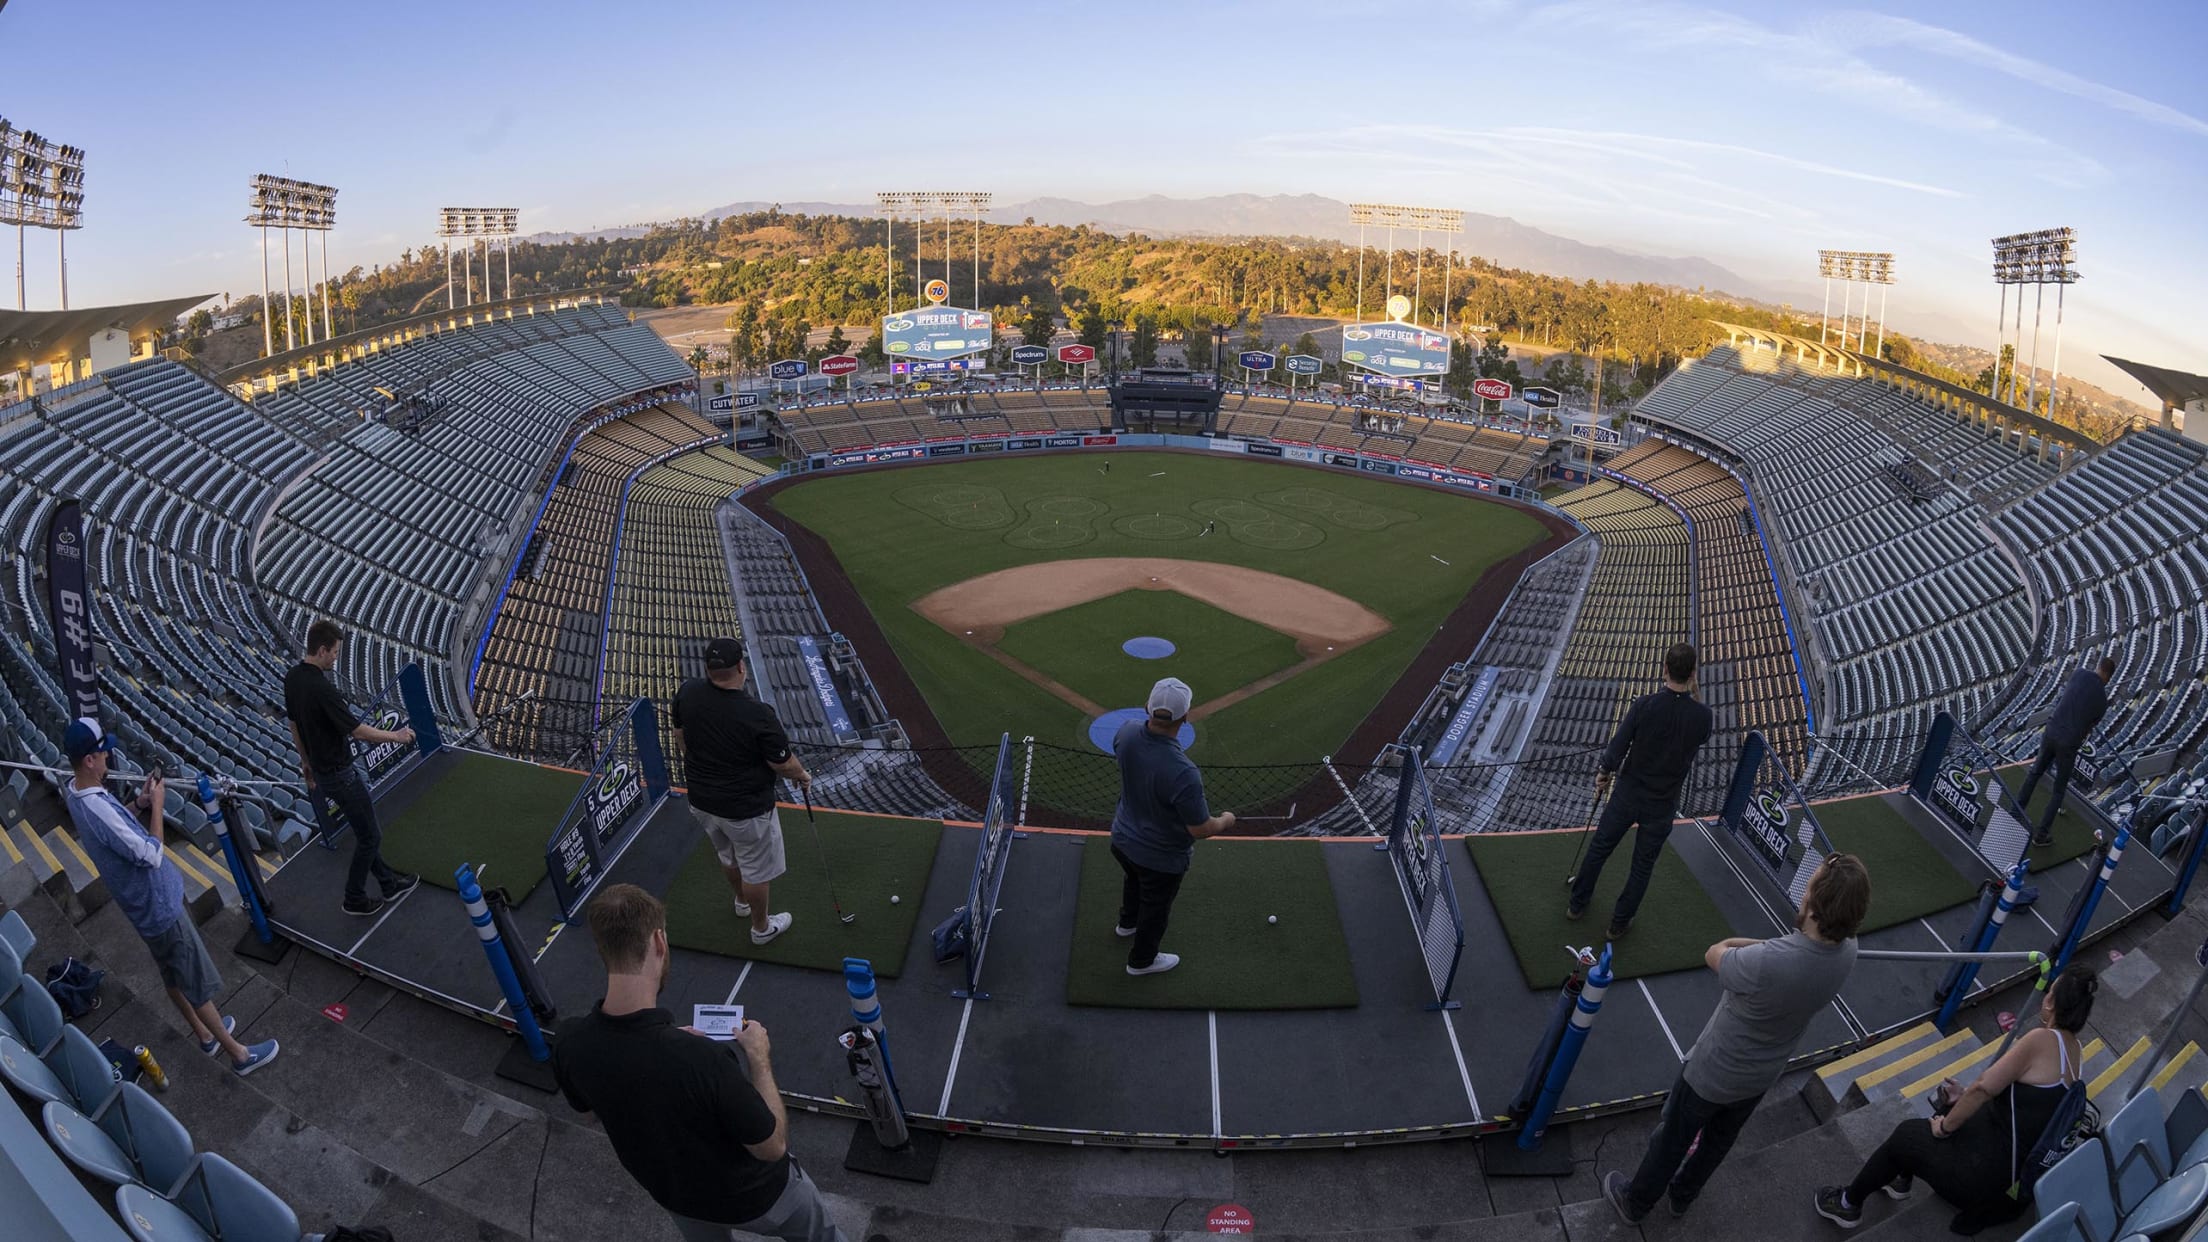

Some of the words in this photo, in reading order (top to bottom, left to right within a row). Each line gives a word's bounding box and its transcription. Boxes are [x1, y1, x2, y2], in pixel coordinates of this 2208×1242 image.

[932, 286, 944, 296] 76
[1393, 302, 1405, 311] 76
[917, 314, 939, 324] UPPER
[940, 313, 957, 323] DECK
[1374, 328, 1396, 339] UPPER
[1397, 330, 1415, 341] DECK
[1015, 351, 1042, 359] Spectrum
[774, 364, 795, 374] blue
[60, 589, 91, 652] #9
[1447, 709, 1472, 741] DODGER
[1466, 680, 1489, 709] STADIUM
[365, 741, 393, 768] UPPER
[2078, 758, 2097, 779] DECK
[588, 795, 595, 812] 5
[595, 795, 621, 831] UPPER
[620, 776, 640, 806] DECK
[1936, 777, 1960, 805] UPPER
[1957, 796, 1979, 821] DECK
[1745, 802, 1769, 836] UPPER
[1766, 826, 1787, 857] DECK
